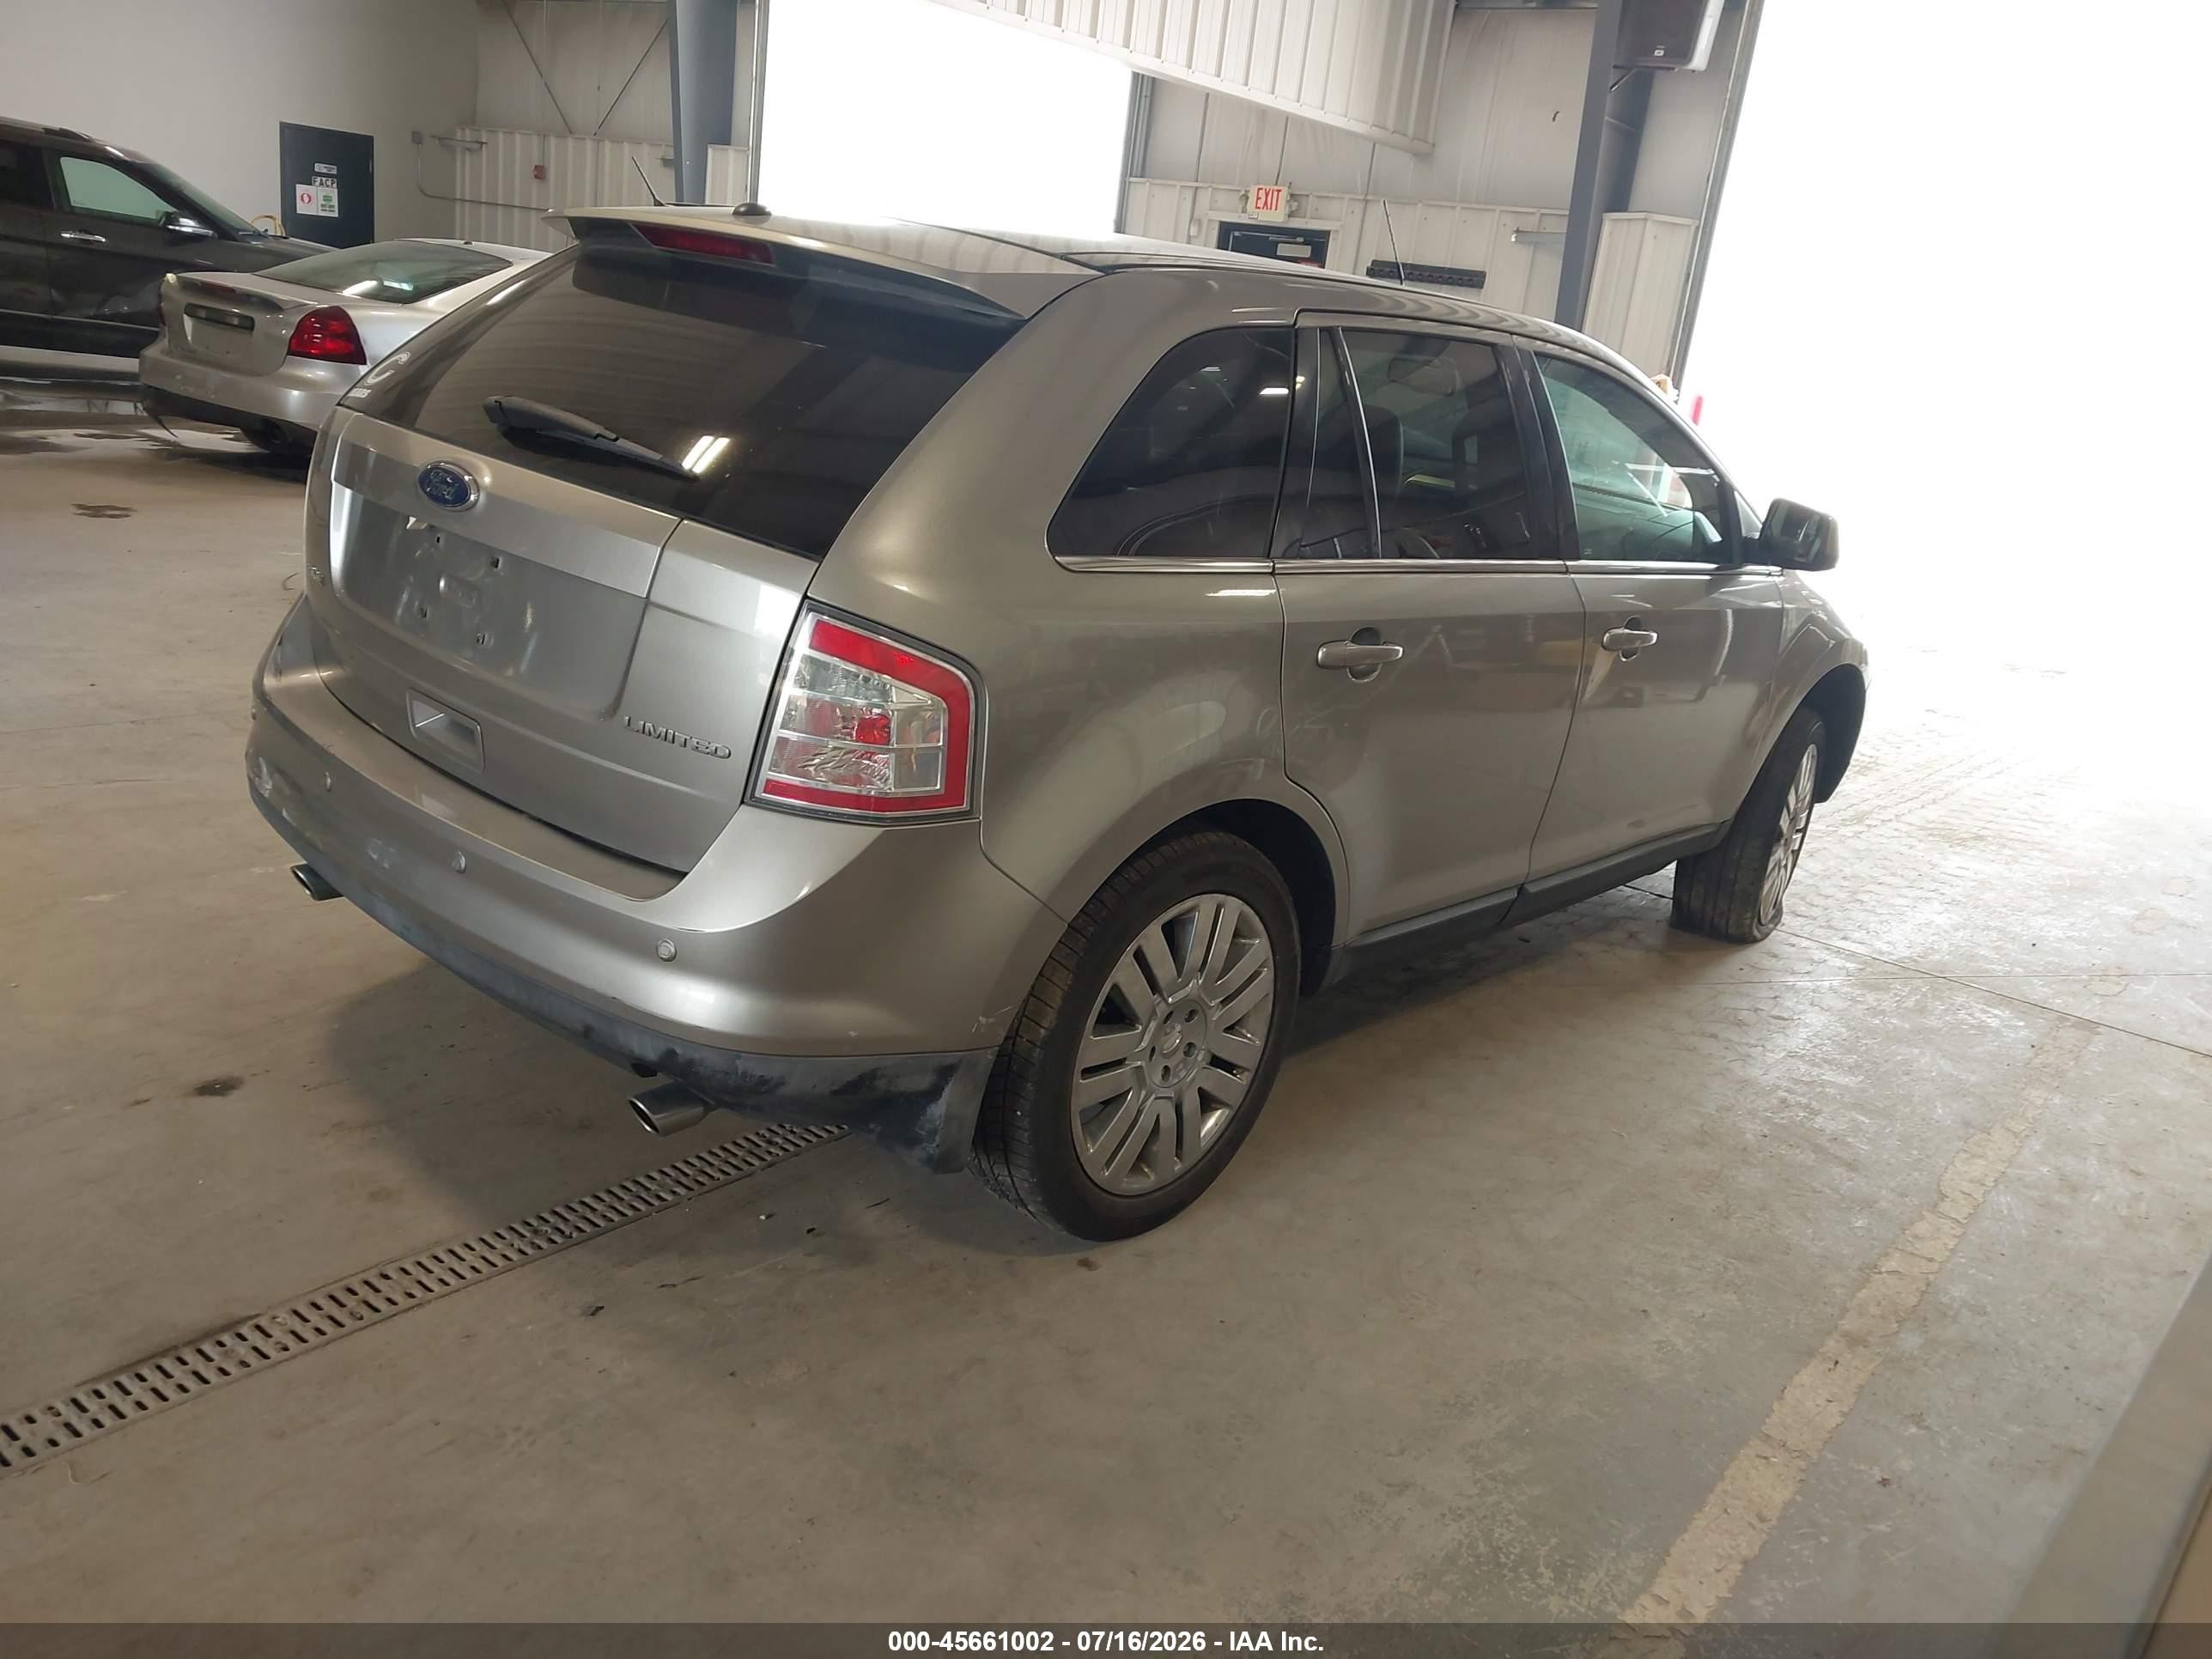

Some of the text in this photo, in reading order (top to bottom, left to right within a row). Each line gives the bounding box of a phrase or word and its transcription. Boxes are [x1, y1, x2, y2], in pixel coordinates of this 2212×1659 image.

[313, 177, 336, 187] FACP
[1255, 187, 1282, 210] EXIT
[623, 715, 732, 759] LIMITED
